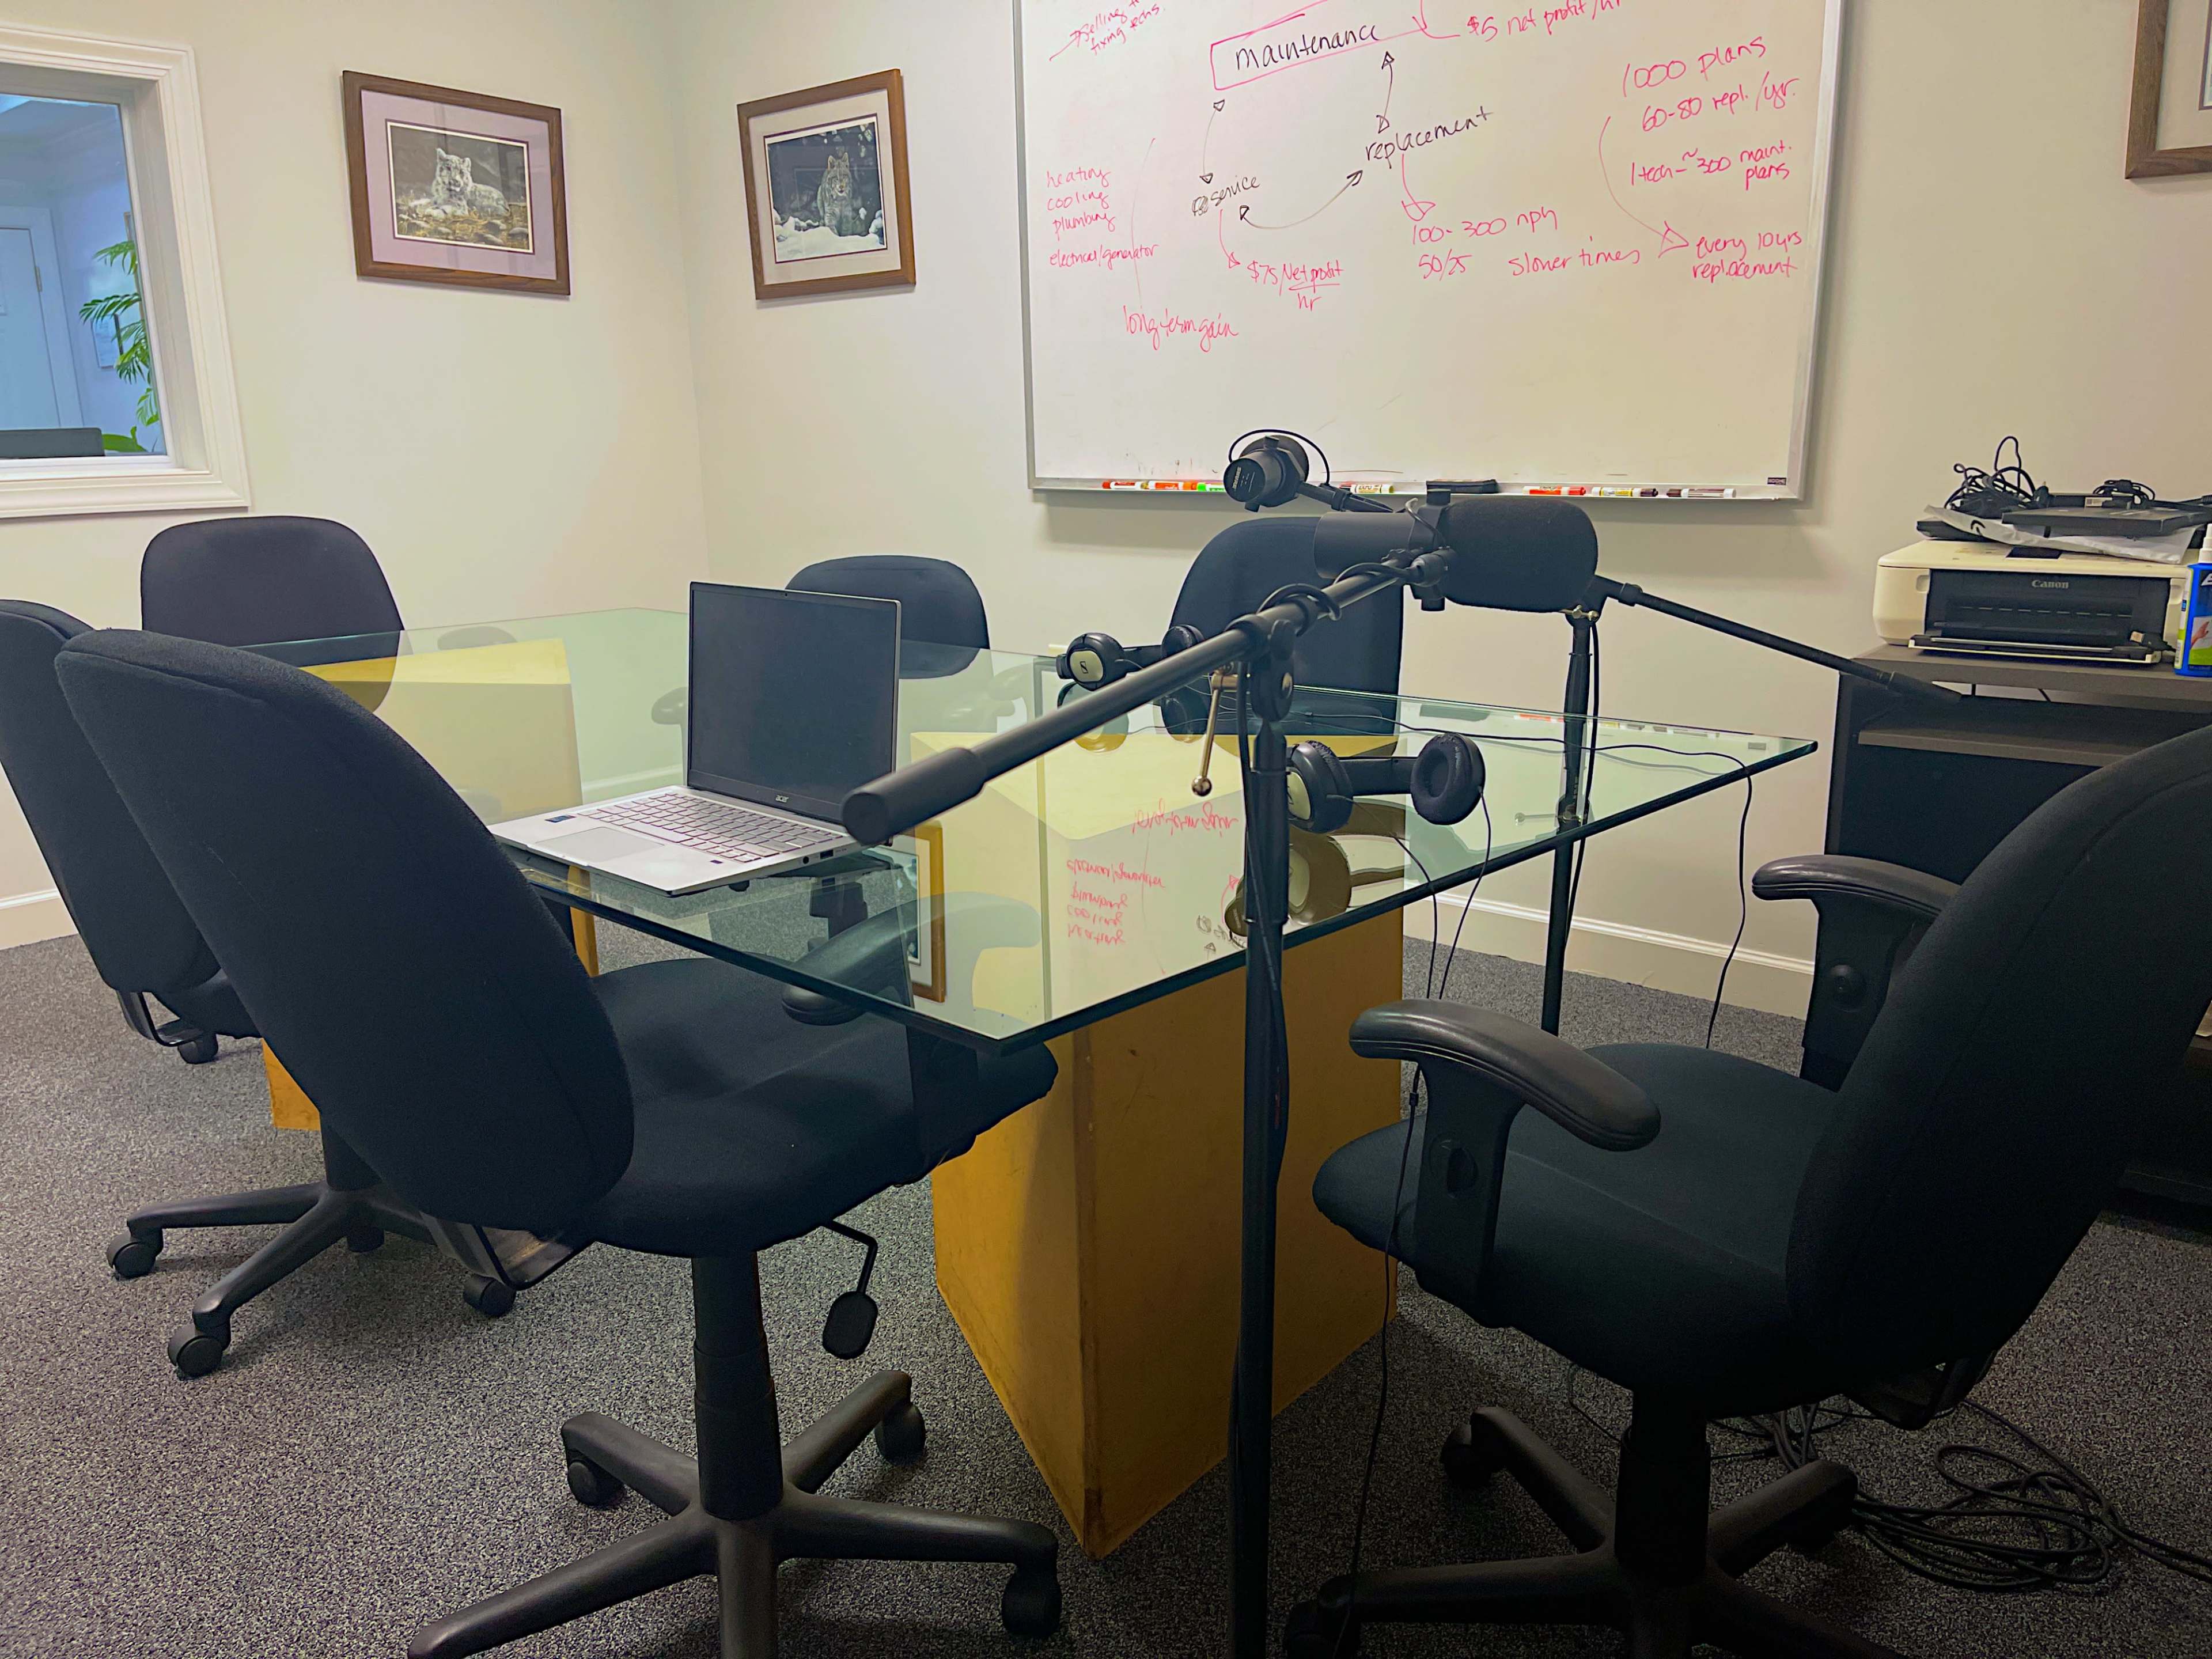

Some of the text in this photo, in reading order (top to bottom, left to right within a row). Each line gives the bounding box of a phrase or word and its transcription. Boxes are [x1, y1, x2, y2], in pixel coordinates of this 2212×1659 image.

[1467, 16, 1498, 42] $5
[1508, 8, 1536, 35] net
[1544, 0, 1586, 35] profit
[1623, 60, 1686, 97] 1000
[1642, 97, 1702, 132] 60-80
[1366, 105, 1494, 169] replacement
[1047, 166, 1111, 188] heating
[1210, 175, 1260, 206] service
[1746, 163, 1790, 191] plans
[1047, 191, 1109, 211] cooling
[1052, 211, 1116, 242] plumbing
[1579, 236, 1640, 264] times
[1696, 237, 1747, 260] every
[1692, 256, 1798, 283] replacement
[1298, 293, 1321, 311] hr
[2032, 579, 2069, 589] Canon
